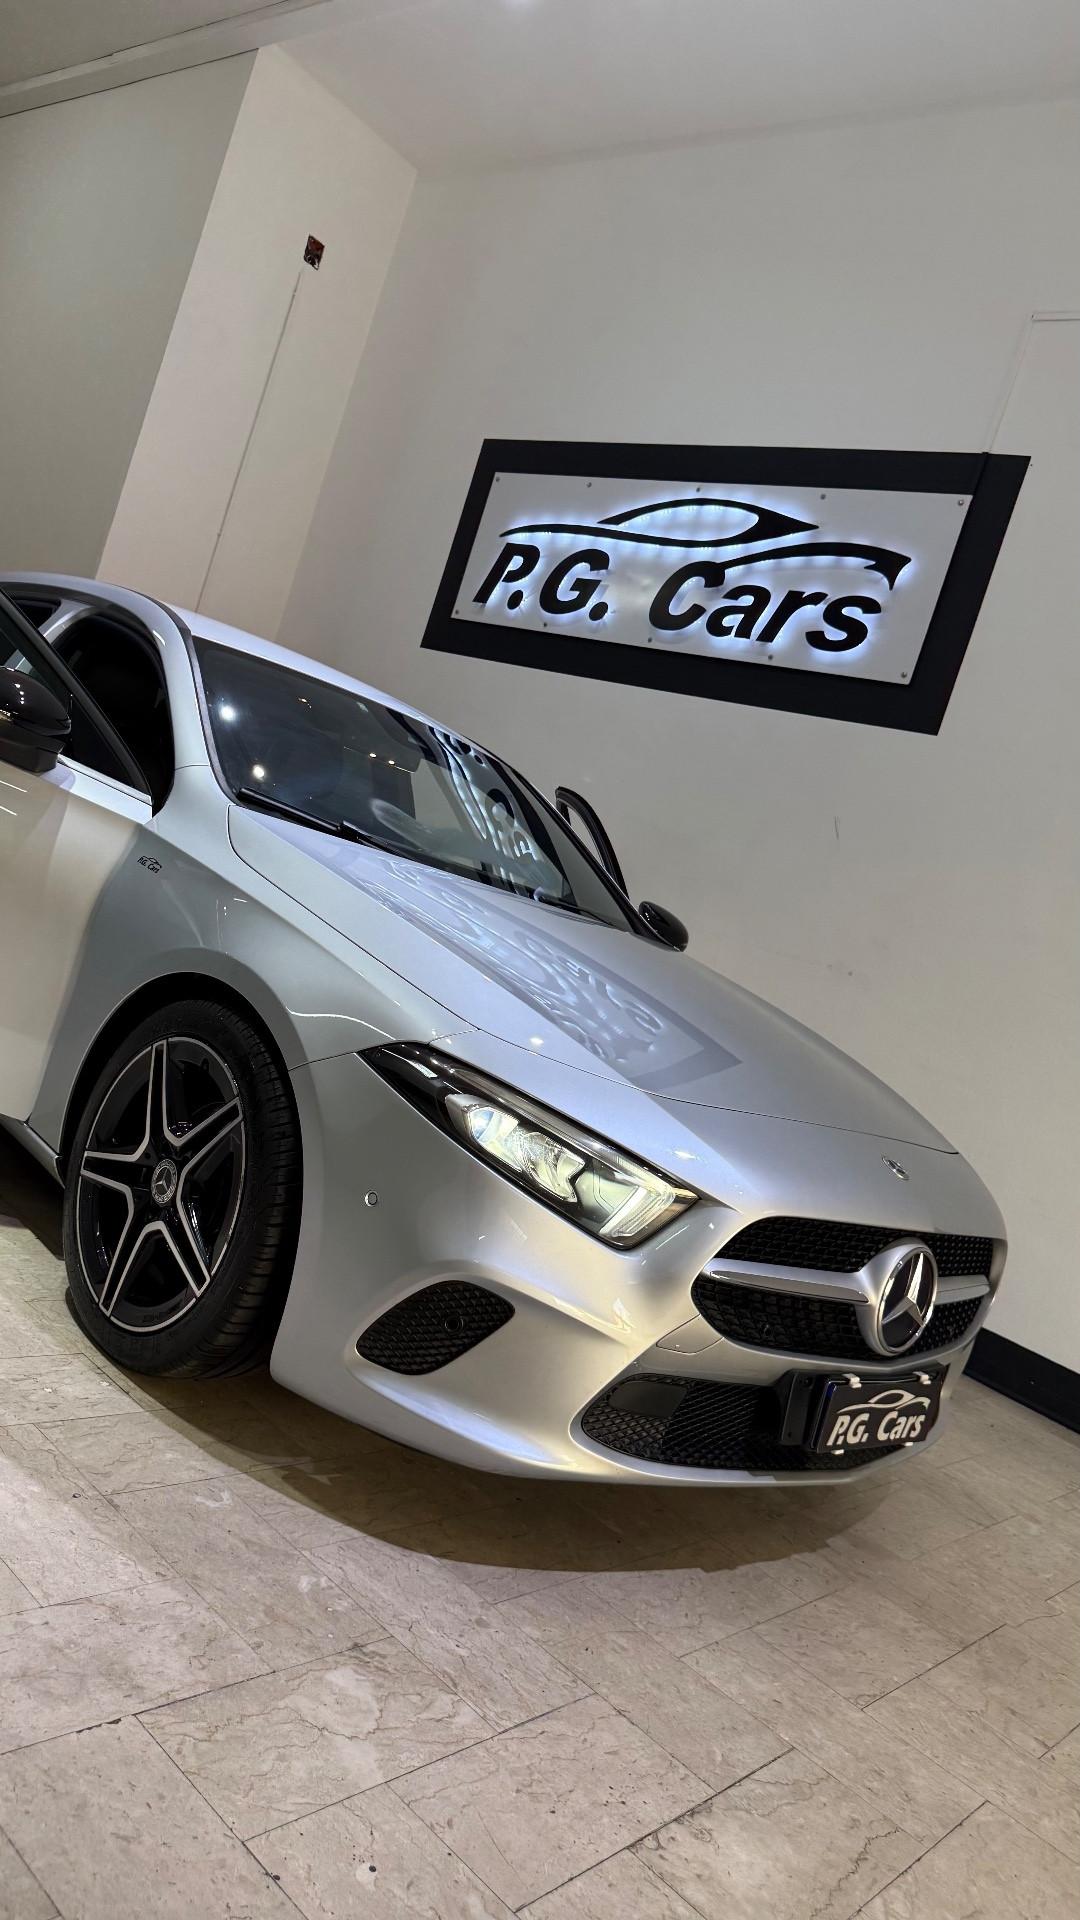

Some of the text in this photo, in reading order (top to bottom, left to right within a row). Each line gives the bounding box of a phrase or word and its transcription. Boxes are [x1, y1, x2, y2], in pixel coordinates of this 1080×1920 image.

[472, 542, 882, 652] P.G. Cars
[826, 1411, 926, 1446] P.G. Cars
